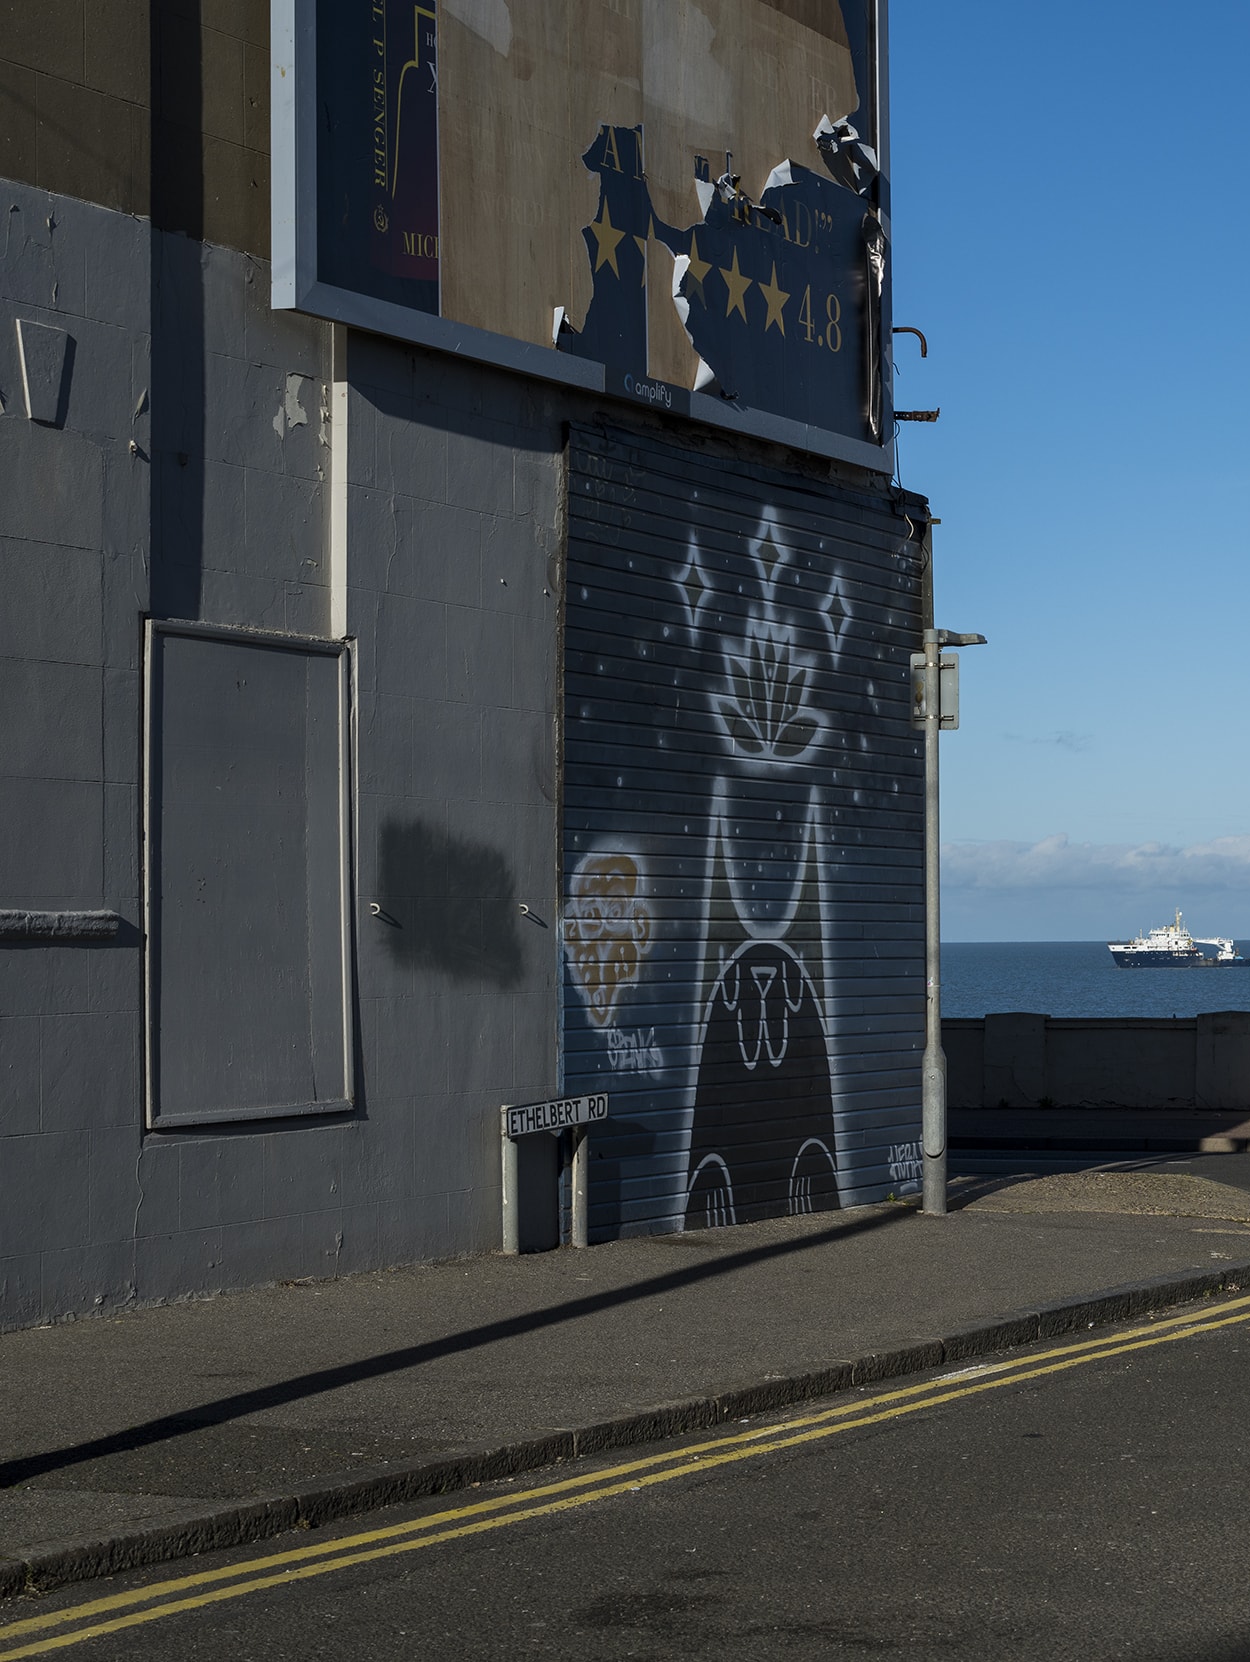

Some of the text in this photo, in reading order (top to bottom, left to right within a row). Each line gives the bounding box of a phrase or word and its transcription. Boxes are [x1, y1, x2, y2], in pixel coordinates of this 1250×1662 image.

[373, 39, 384, 57] P
[373, 68, 386, 188] SENGER
[798, 283, 843, 353] 4.8
[635, 382, 672, 409] amplify
[510, 1096, 606, 1135] ETHELBERT RD
